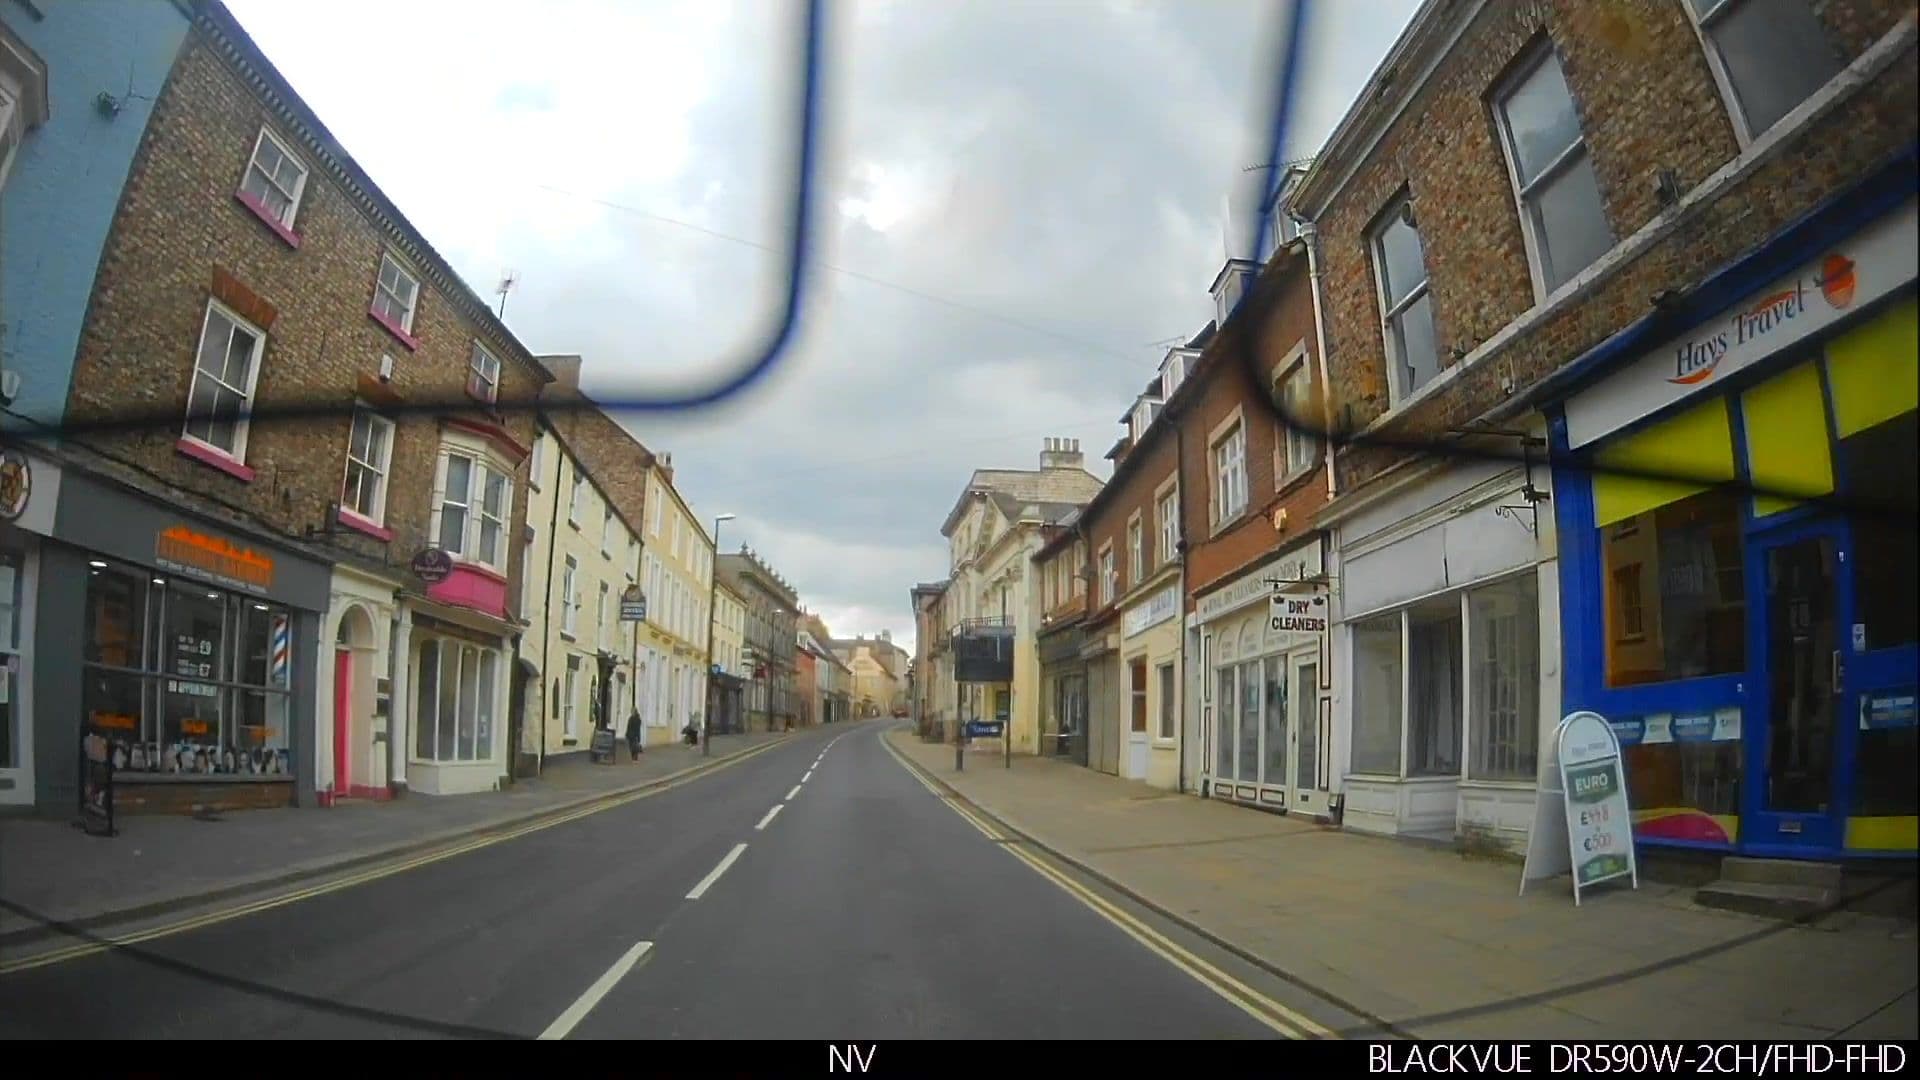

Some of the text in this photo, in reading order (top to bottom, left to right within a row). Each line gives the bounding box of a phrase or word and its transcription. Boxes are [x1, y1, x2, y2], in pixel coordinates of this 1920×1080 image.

[1676, 280, 1805, 377] Hays Travel
[1288, 599, 1310, 614] DRY
[1271, 616, 1326, 632] CLEANERS
[1575, 772, 1609, 792] EURO
